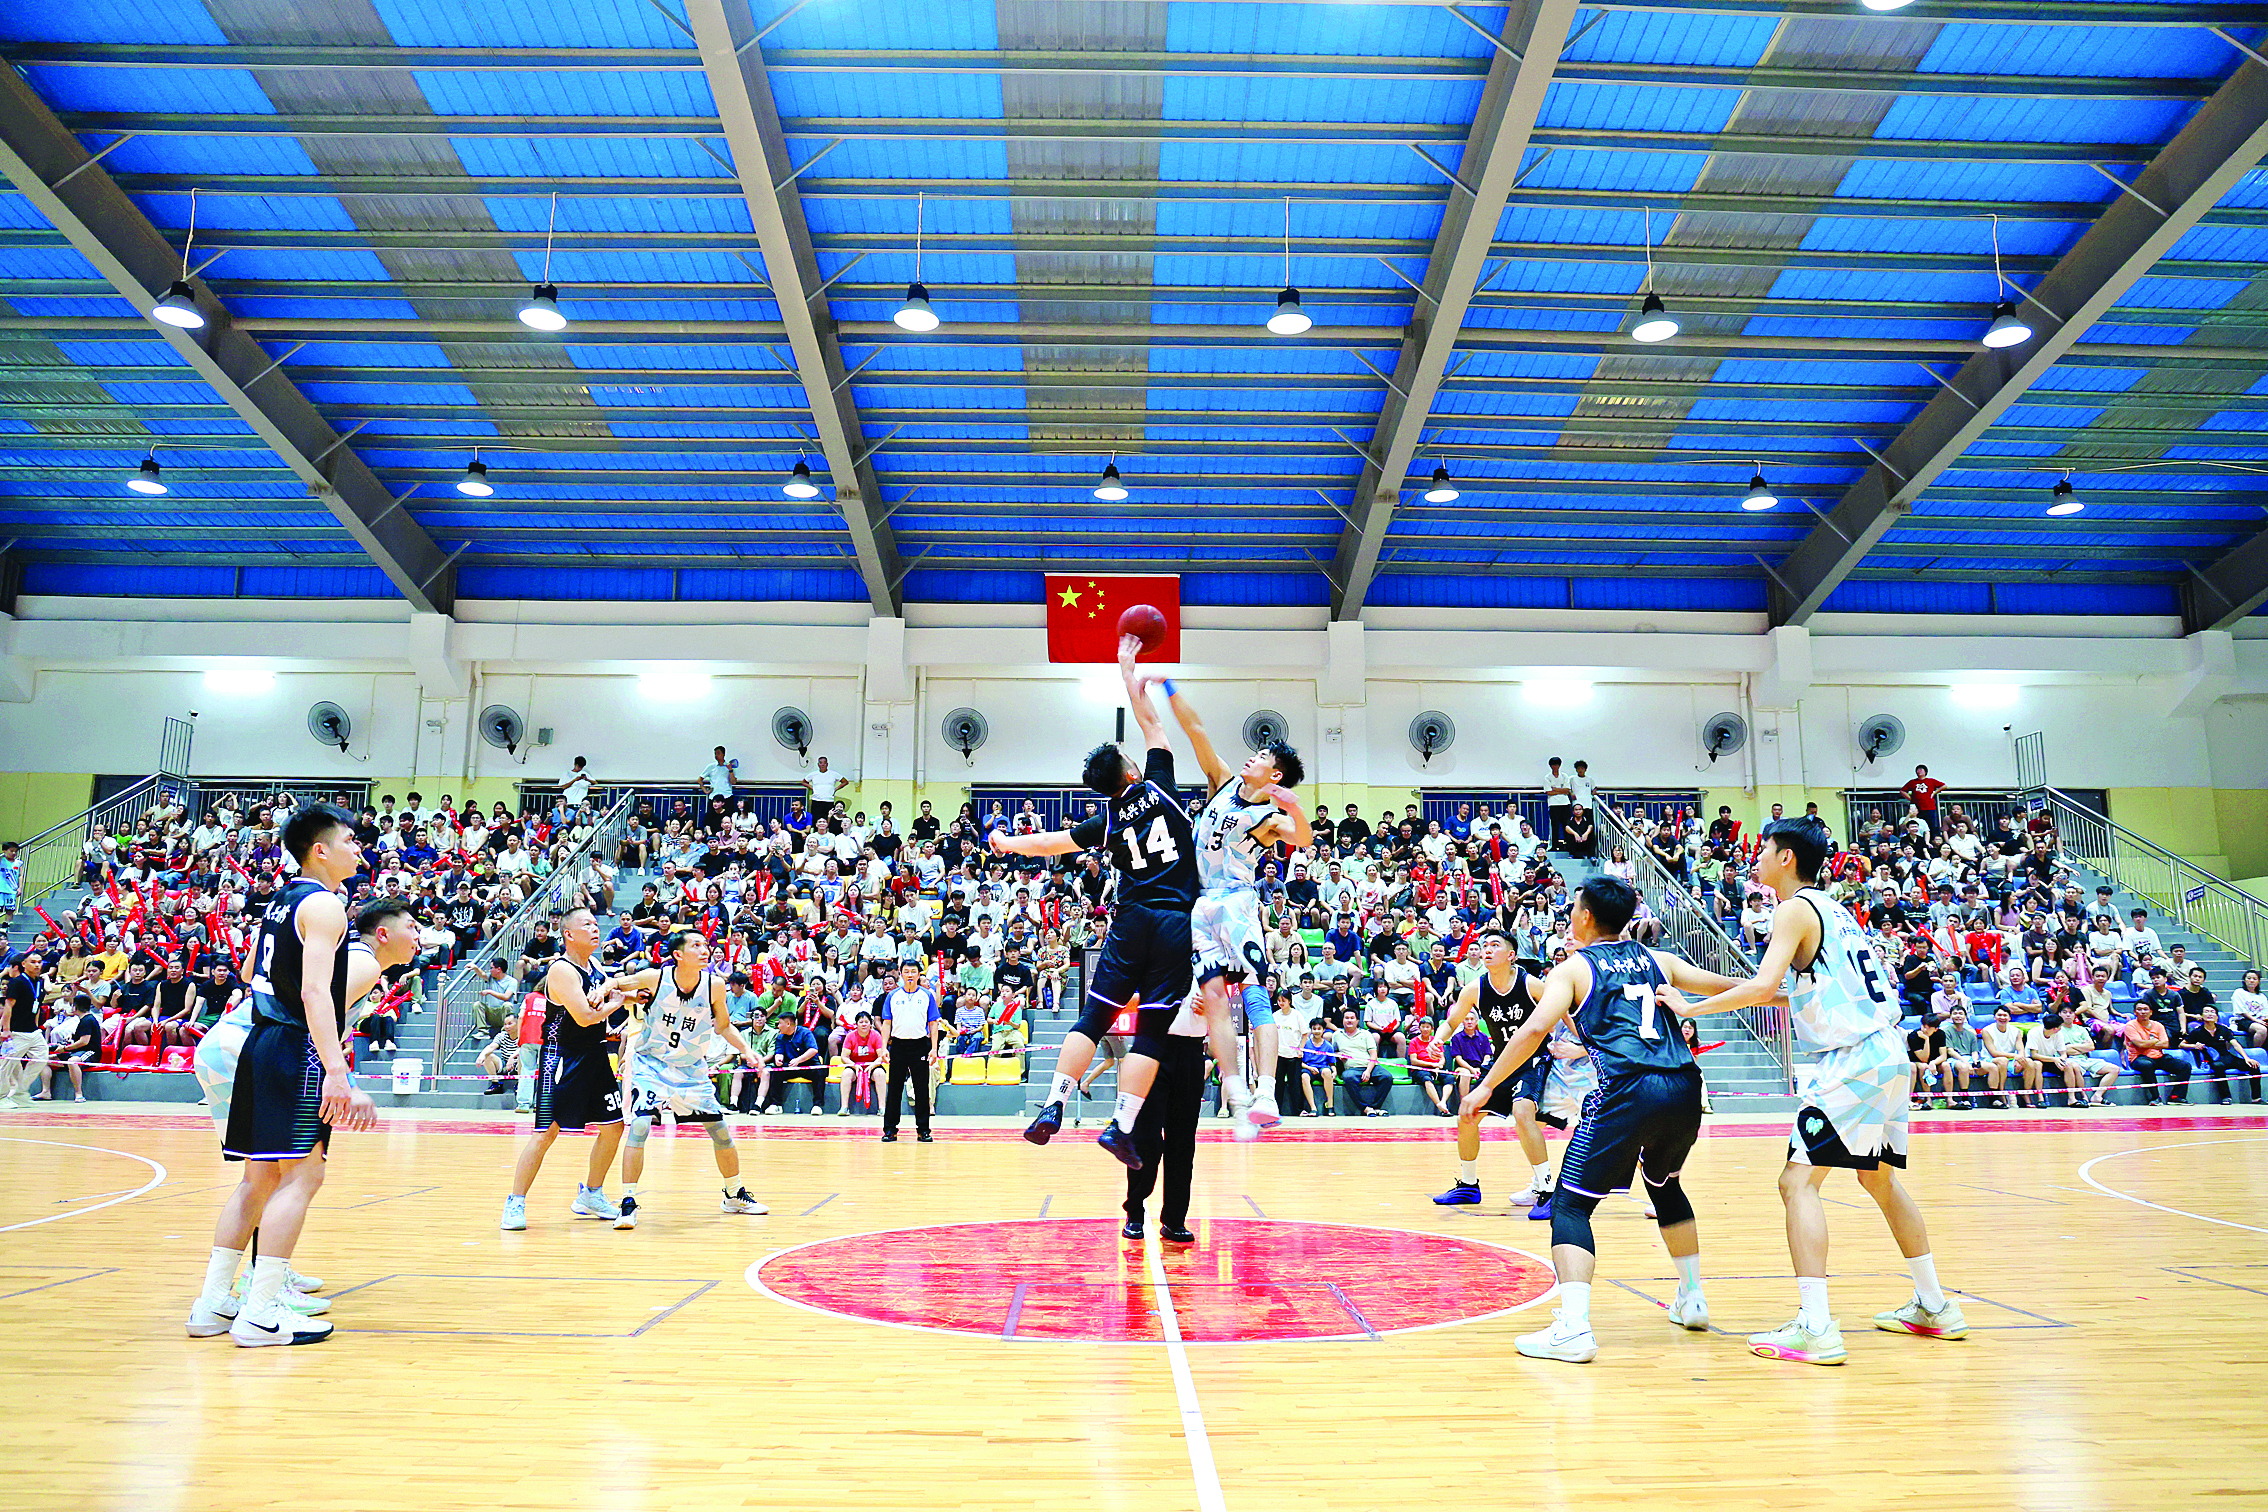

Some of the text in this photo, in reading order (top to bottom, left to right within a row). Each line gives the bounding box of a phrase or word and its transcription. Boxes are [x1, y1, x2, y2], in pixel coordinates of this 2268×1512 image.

[1122, 814, 1180, 870] 14
[1489, 1003, 1524, 1023] 铁场
[1622, 981, 1661, 1040] 7
[661, 1012, 696, 1033] 中岗
[668, 1031, 681, 1049] 9
[646, 1090, 657, 1105] 9
